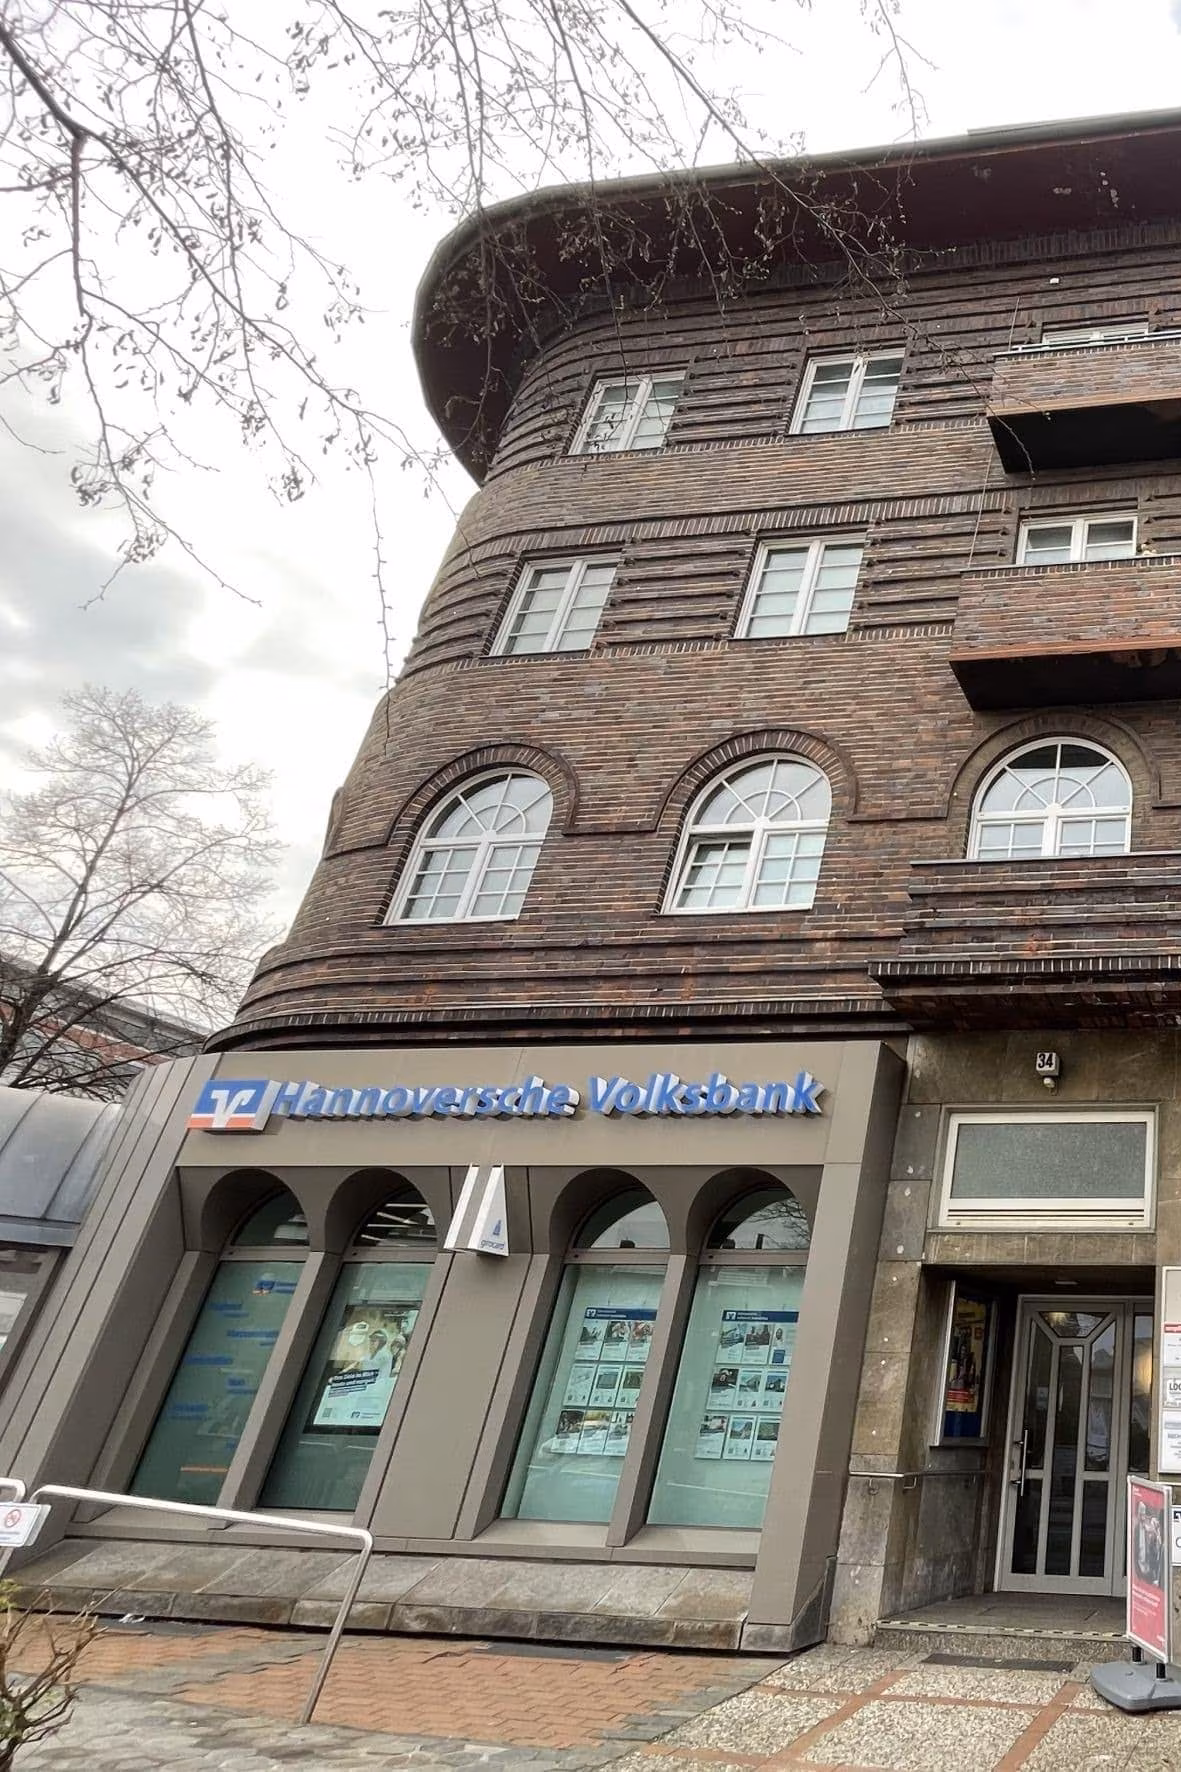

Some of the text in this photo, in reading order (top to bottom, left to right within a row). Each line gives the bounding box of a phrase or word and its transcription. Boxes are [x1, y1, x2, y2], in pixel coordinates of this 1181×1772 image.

[1038, 1053, 1053, 1068] 34
[272, 1071, 824, 1117] Hannoversche Volksbank
